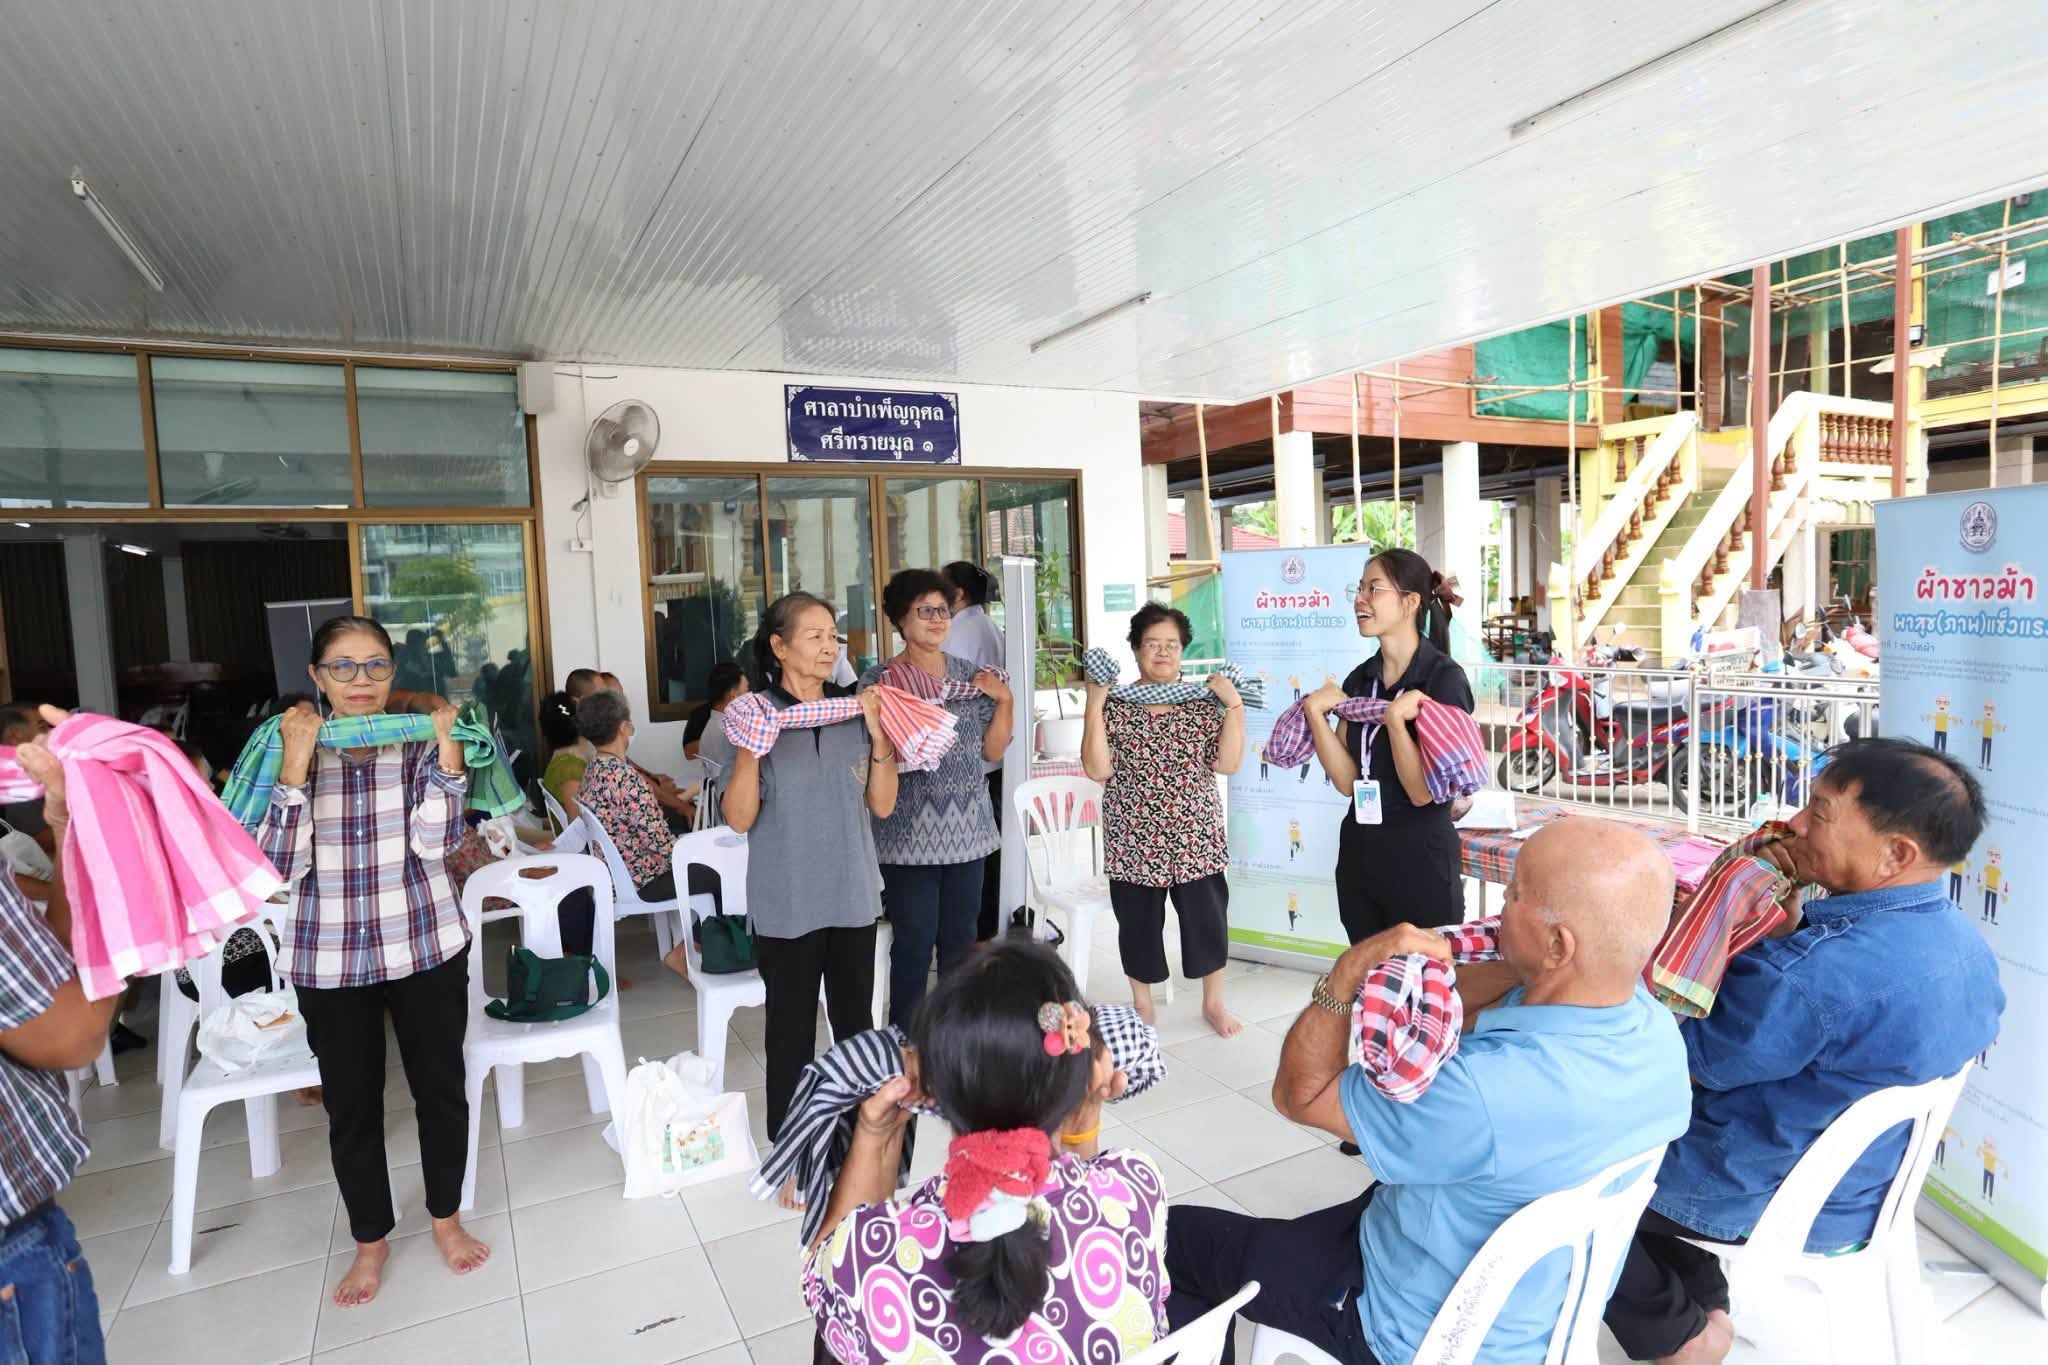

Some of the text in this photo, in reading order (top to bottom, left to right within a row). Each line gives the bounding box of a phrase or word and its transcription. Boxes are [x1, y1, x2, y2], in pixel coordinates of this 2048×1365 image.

[804, 395, 944, 429] ศาลาบำเพ็ญกุศล
[820, 425, 934, 460] ศรีทรายมูล ๑
[1894, 607, 2048, 637] พาสุข(ภาพ)แข็งแร
